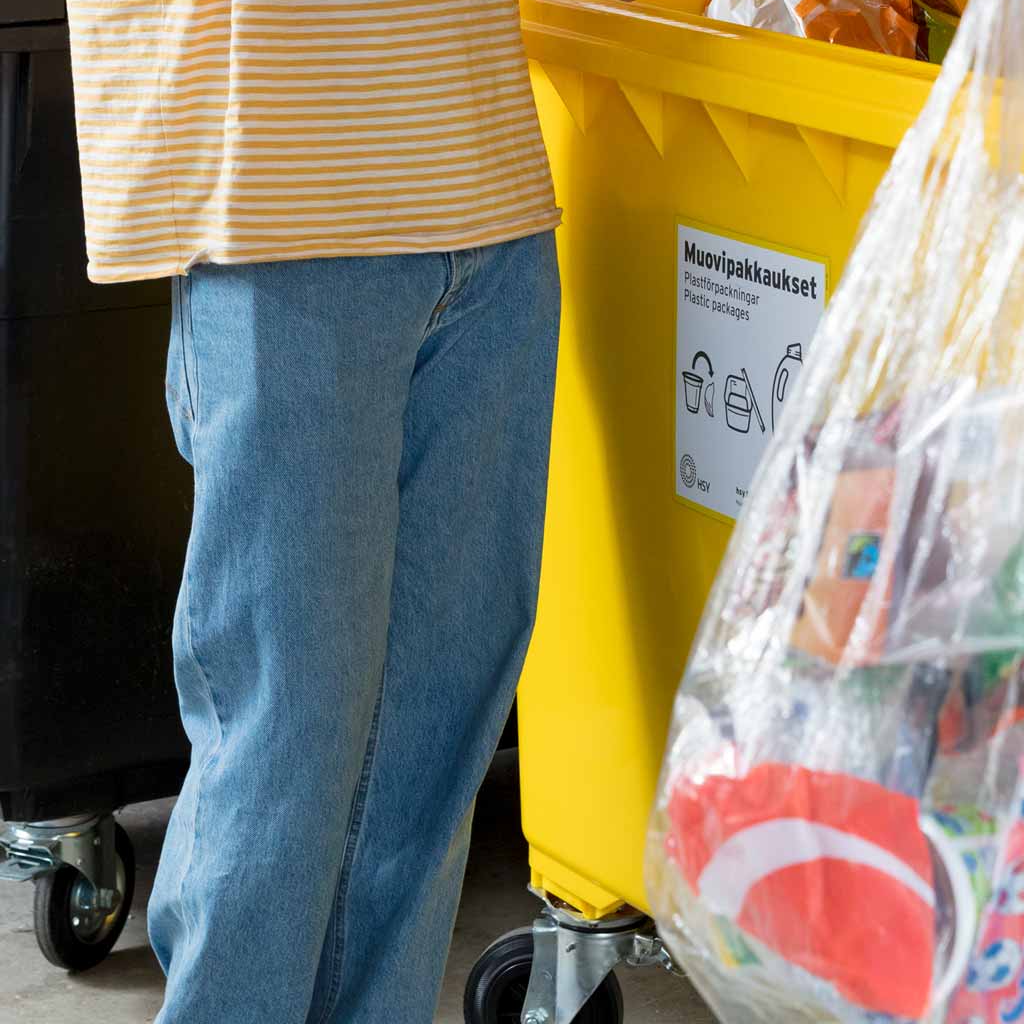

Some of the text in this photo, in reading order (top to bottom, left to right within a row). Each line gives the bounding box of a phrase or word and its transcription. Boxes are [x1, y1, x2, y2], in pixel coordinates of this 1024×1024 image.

[684, 239, 817, 299] Muovipakkaukset
[684, 271, 760, 306] Plastförpackningar
[684, 288, 750, 321] Plastic packages
[697, 478, 711, 493] HSY
